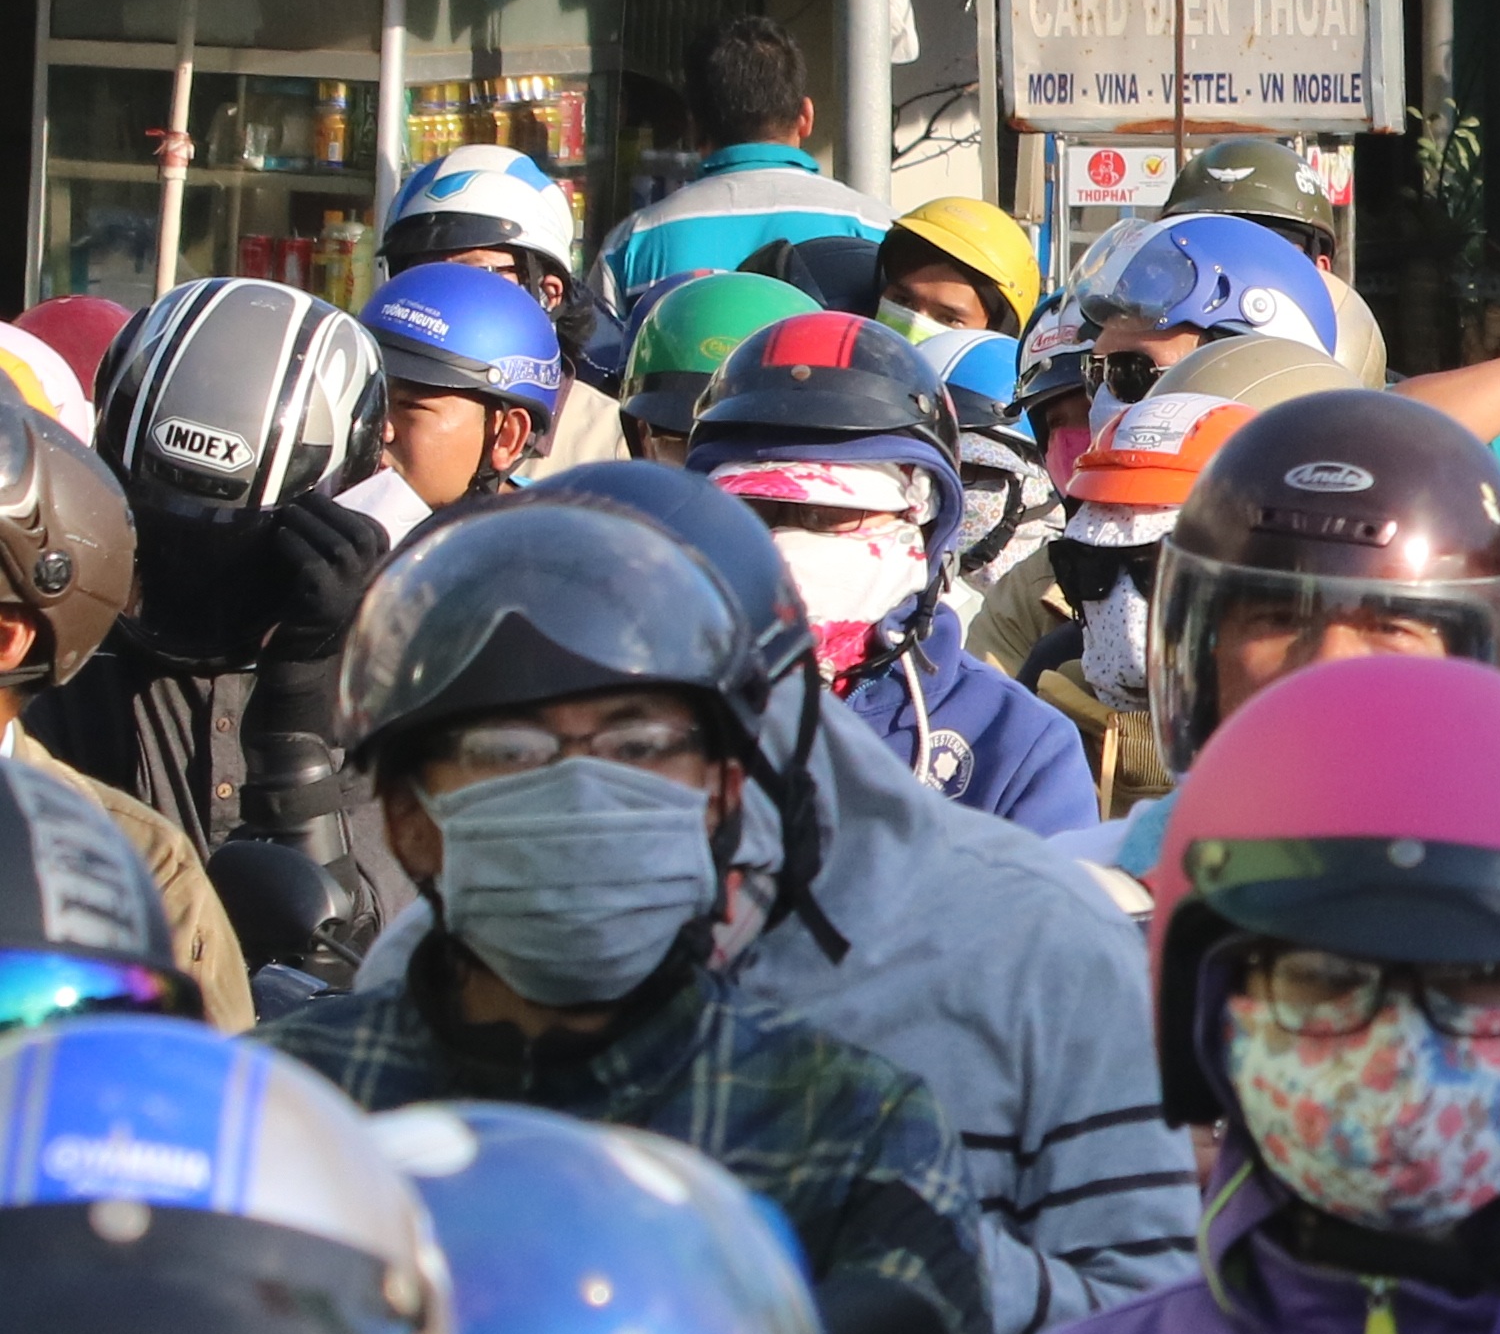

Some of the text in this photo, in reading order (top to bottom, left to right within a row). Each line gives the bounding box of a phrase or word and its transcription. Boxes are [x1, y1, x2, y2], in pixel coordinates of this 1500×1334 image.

[1028, 72, 1362, 105] MOBI VINA VETTEL VN MOBILE
[166, 423, 237, 465] INDEX
